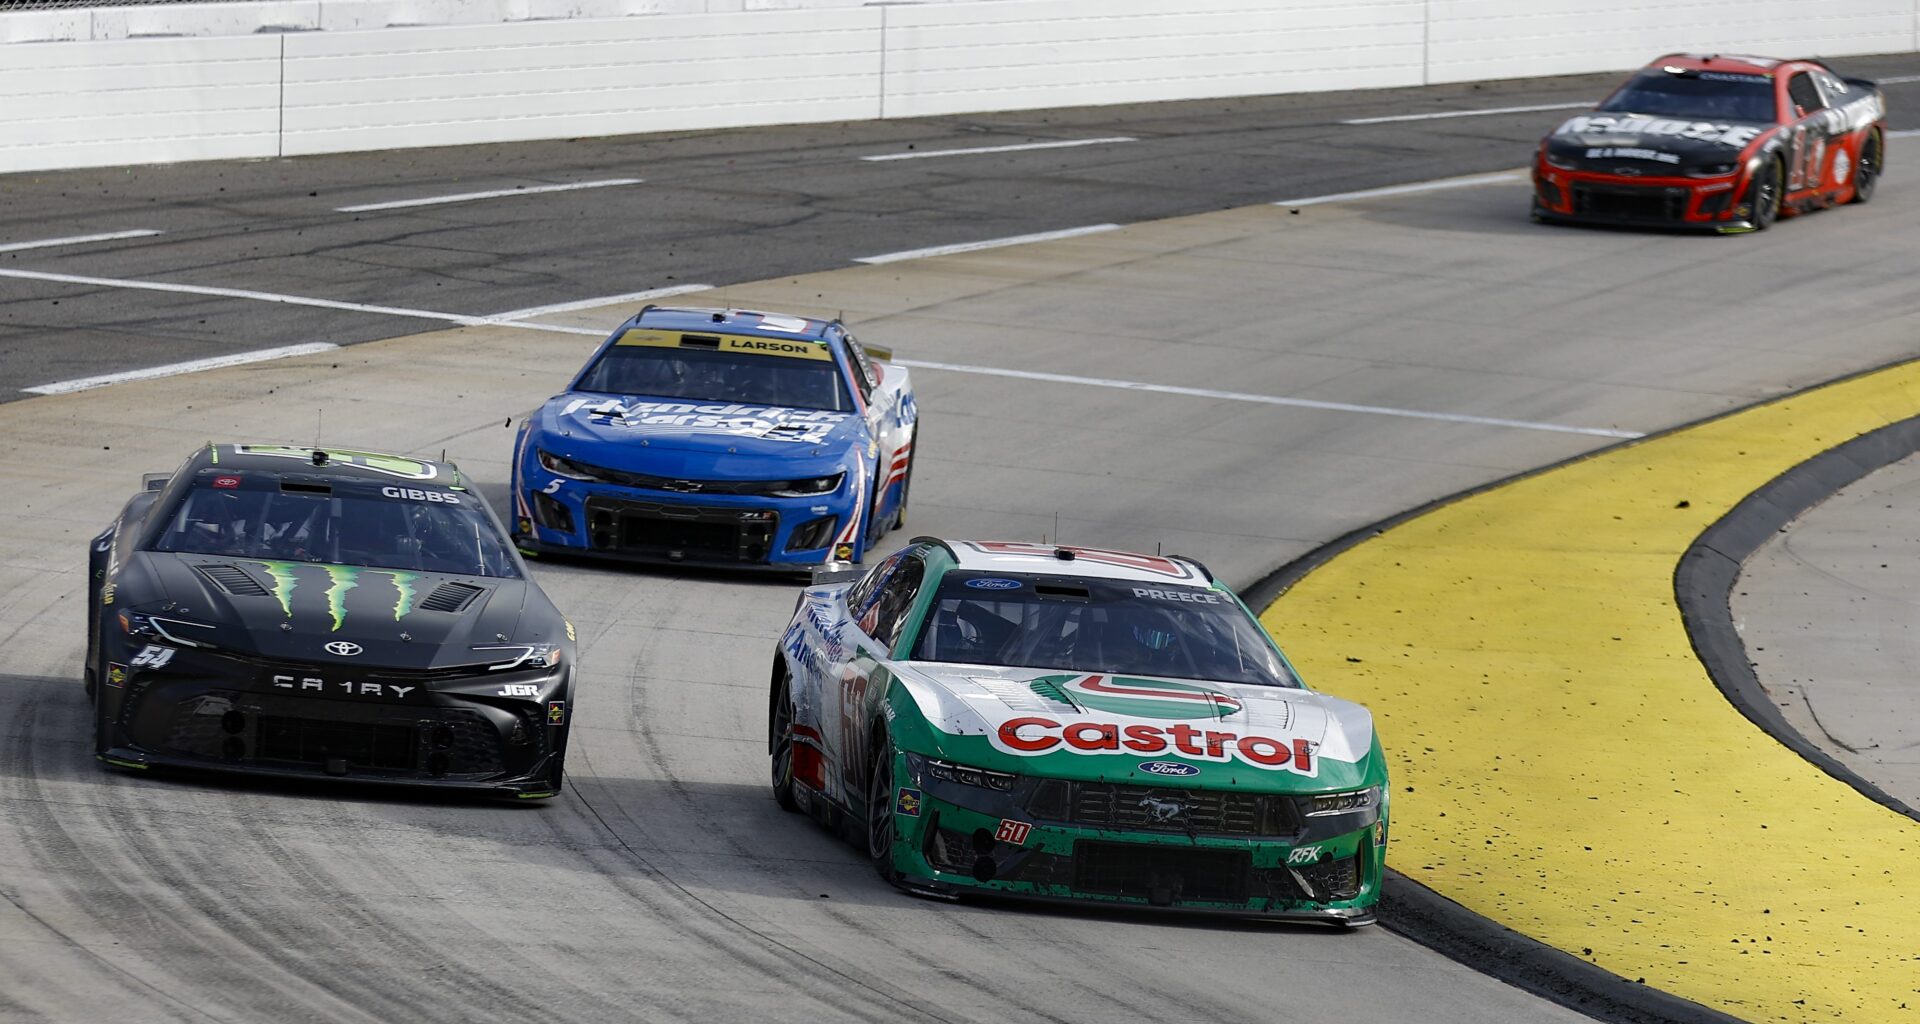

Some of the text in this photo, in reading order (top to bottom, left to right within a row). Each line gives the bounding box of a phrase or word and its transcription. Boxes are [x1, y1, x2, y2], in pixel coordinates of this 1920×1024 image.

[730, 339, 808, 354] LARSON
[542, 478, 567, 494] 5
[381, 486, 461, 504] GIBBS
[976, 578, 1013, 590] Ford
[1132, 588, 1220, 605] PREECE
[131, 645, 178, 670] 54
[497, 684, 541, 697] JGR
[997, 716, 1314, 773] Castrol
[1150, 762, 1188, 775] Ford
[997, 819, 1031, 844] 60
